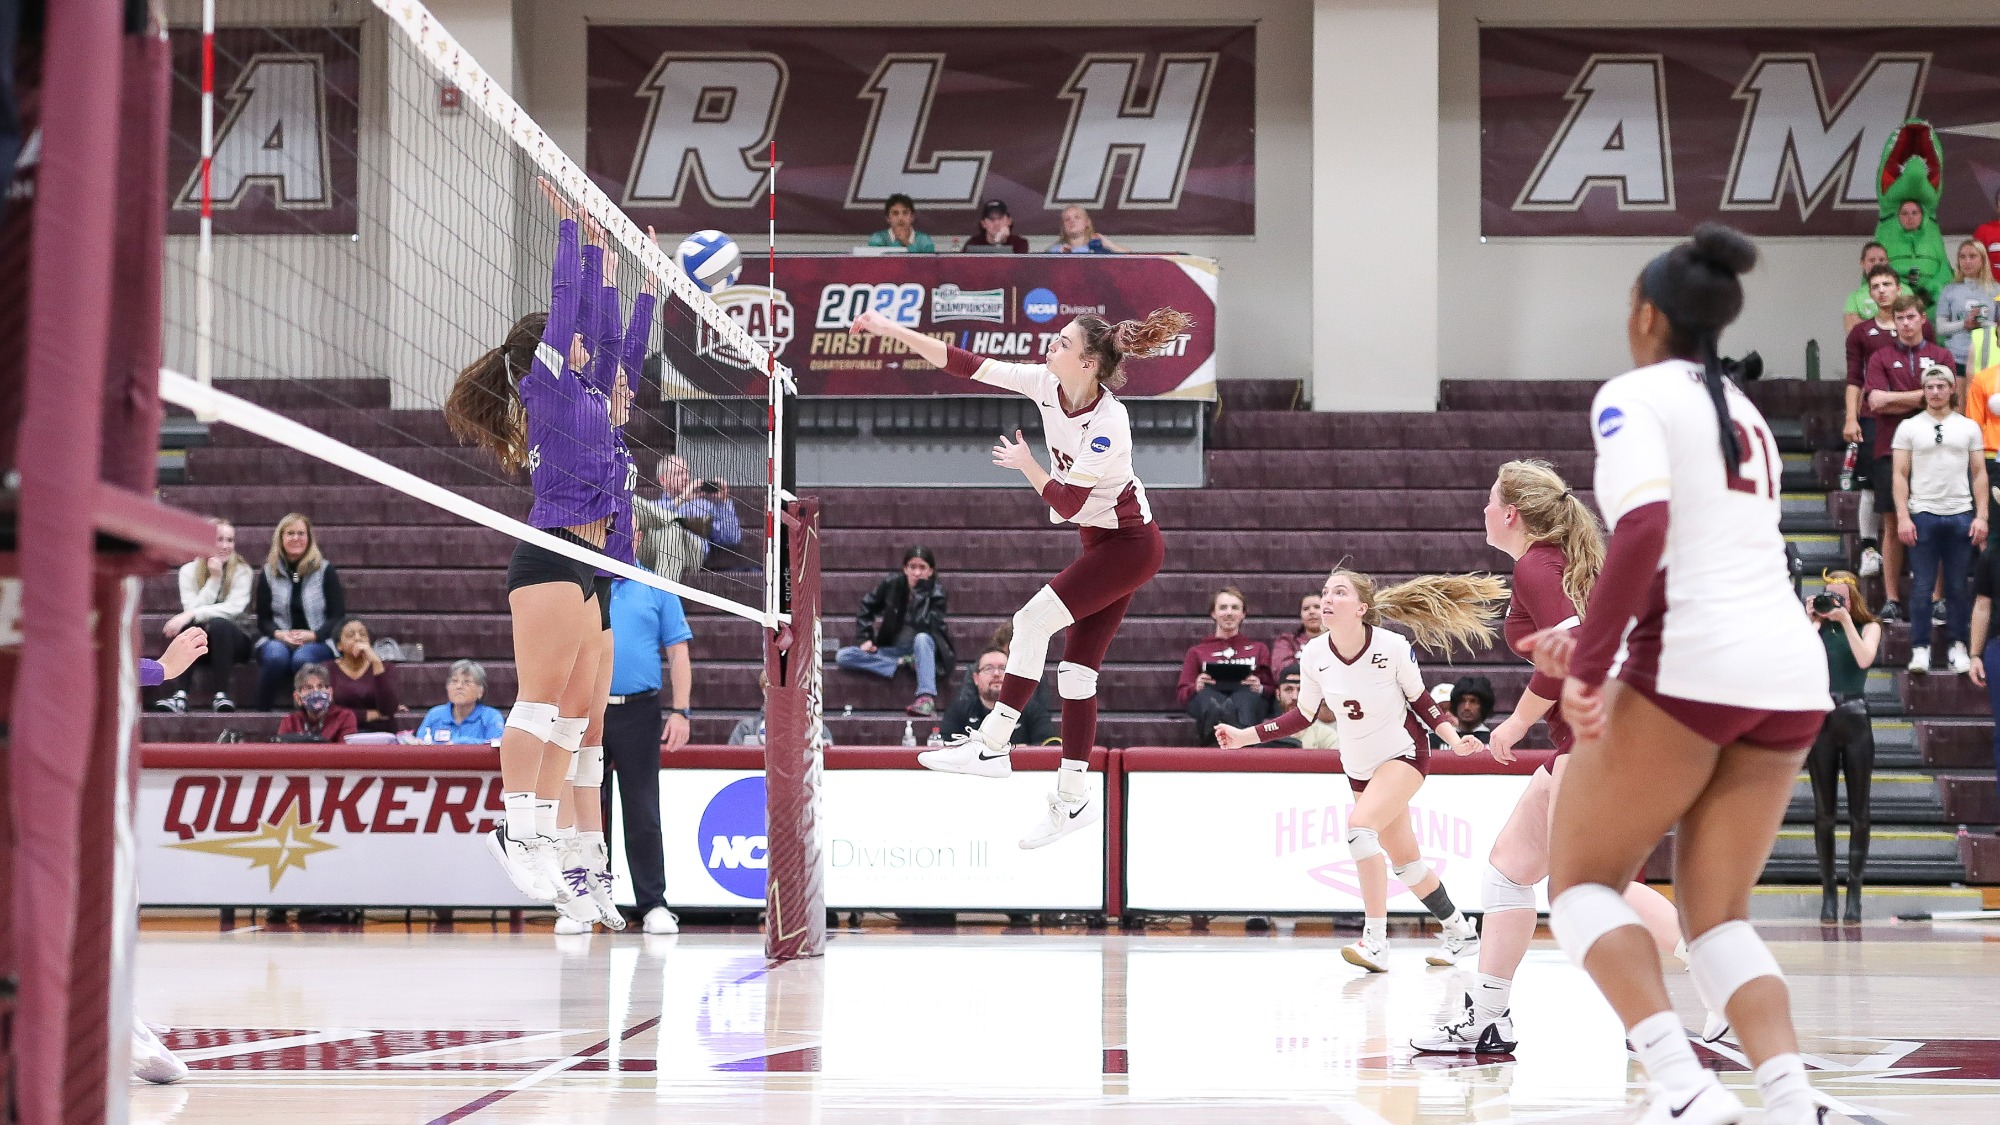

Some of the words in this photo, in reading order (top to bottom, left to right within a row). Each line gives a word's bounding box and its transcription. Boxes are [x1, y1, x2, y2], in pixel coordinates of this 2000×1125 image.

[819, 286, 923, 325] 2022
[1026, 303, 1058, 315] NCAA
[1060, 303, 1096, 315] Division
[810, 331, 875, 355] FIRST
[972, 331, 1034, 355] HCAC
[1726, 419, 1774, 500] 21
[1343, 700, 1364, 720] 3
[1275, 803, 1472, 859] HEAAND
[831, 838, 954, 868] Division
